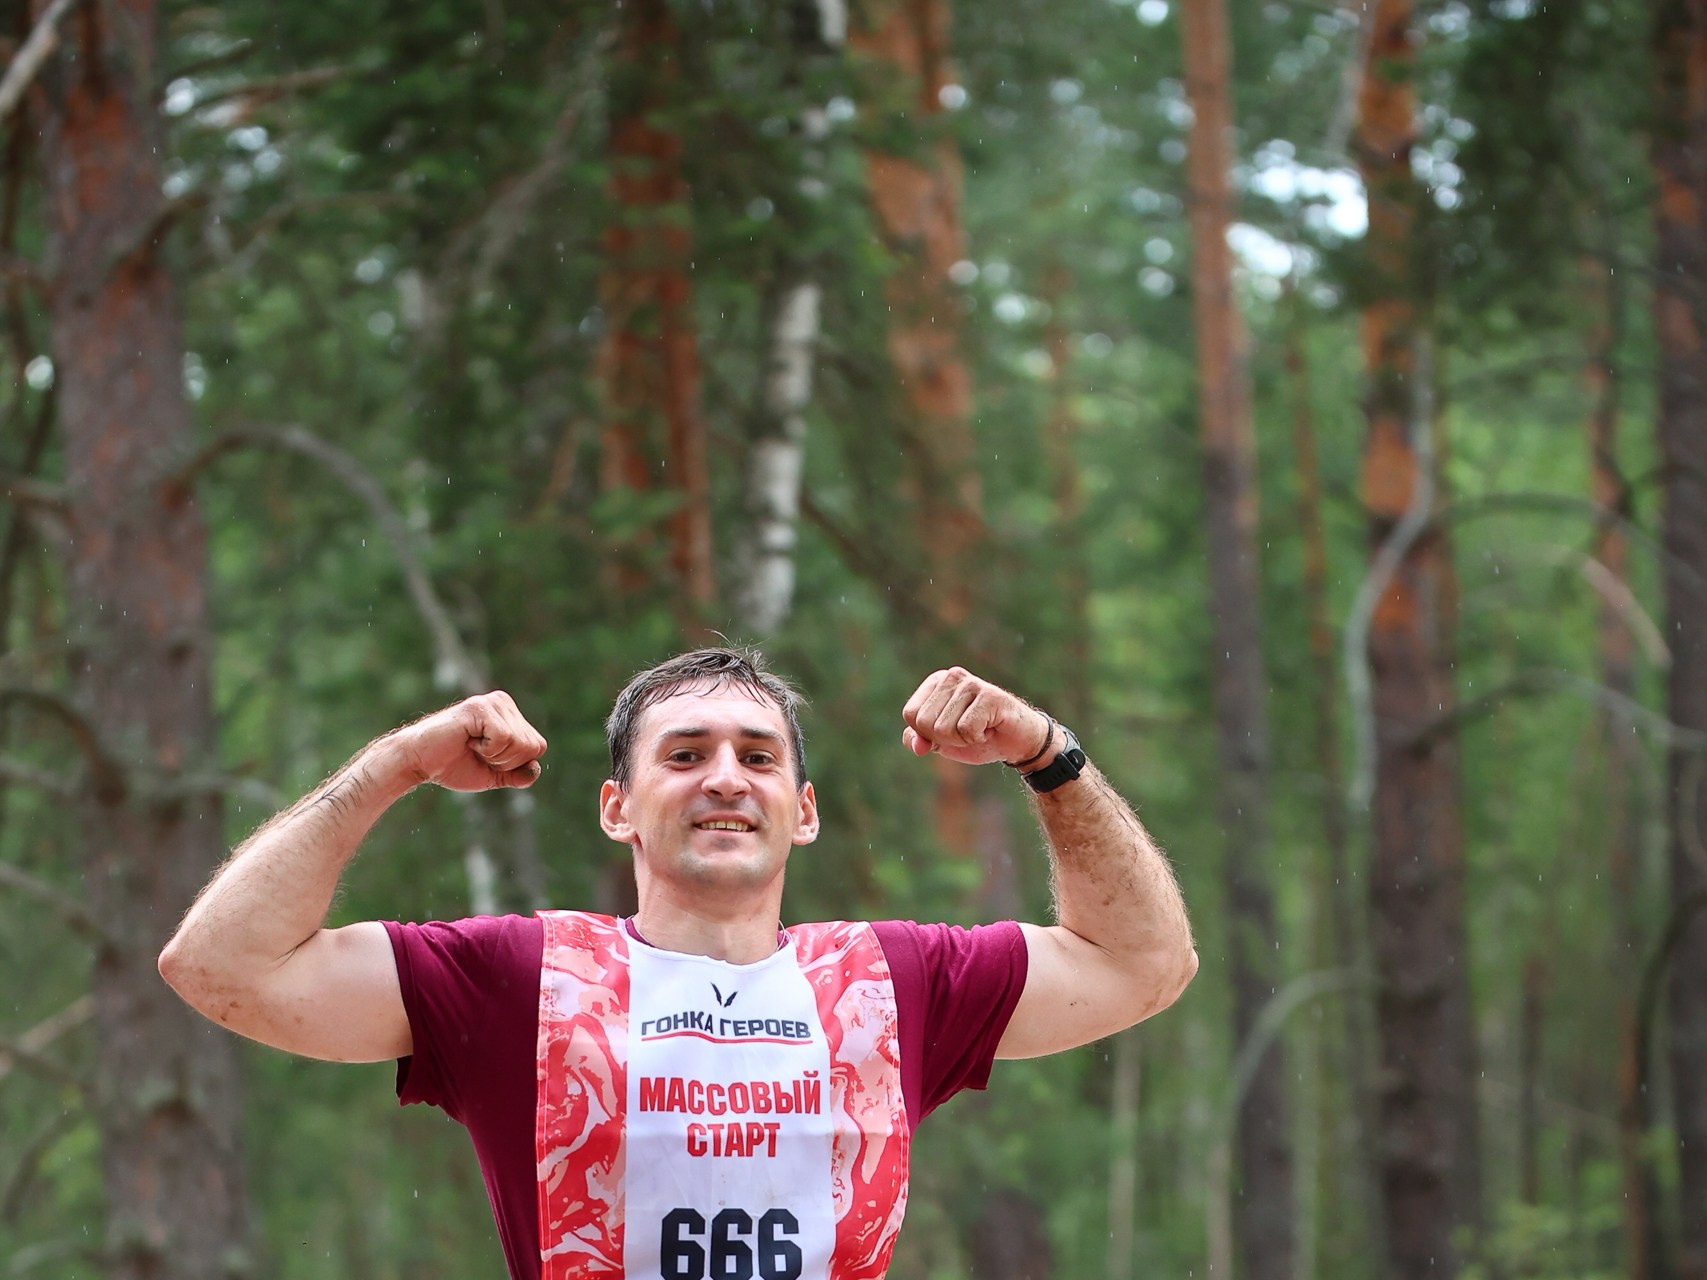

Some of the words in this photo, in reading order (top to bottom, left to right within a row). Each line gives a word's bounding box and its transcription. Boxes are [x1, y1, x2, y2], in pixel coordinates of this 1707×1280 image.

[641, 1011, 713, 1036] ГОНКА
[720, 1018, 811, 1039] ГЕРОЕВ
[639, 1070, 821, 1116] МАССОВЫЙ
[687, 1122, 781, 1158] СТАРТ
